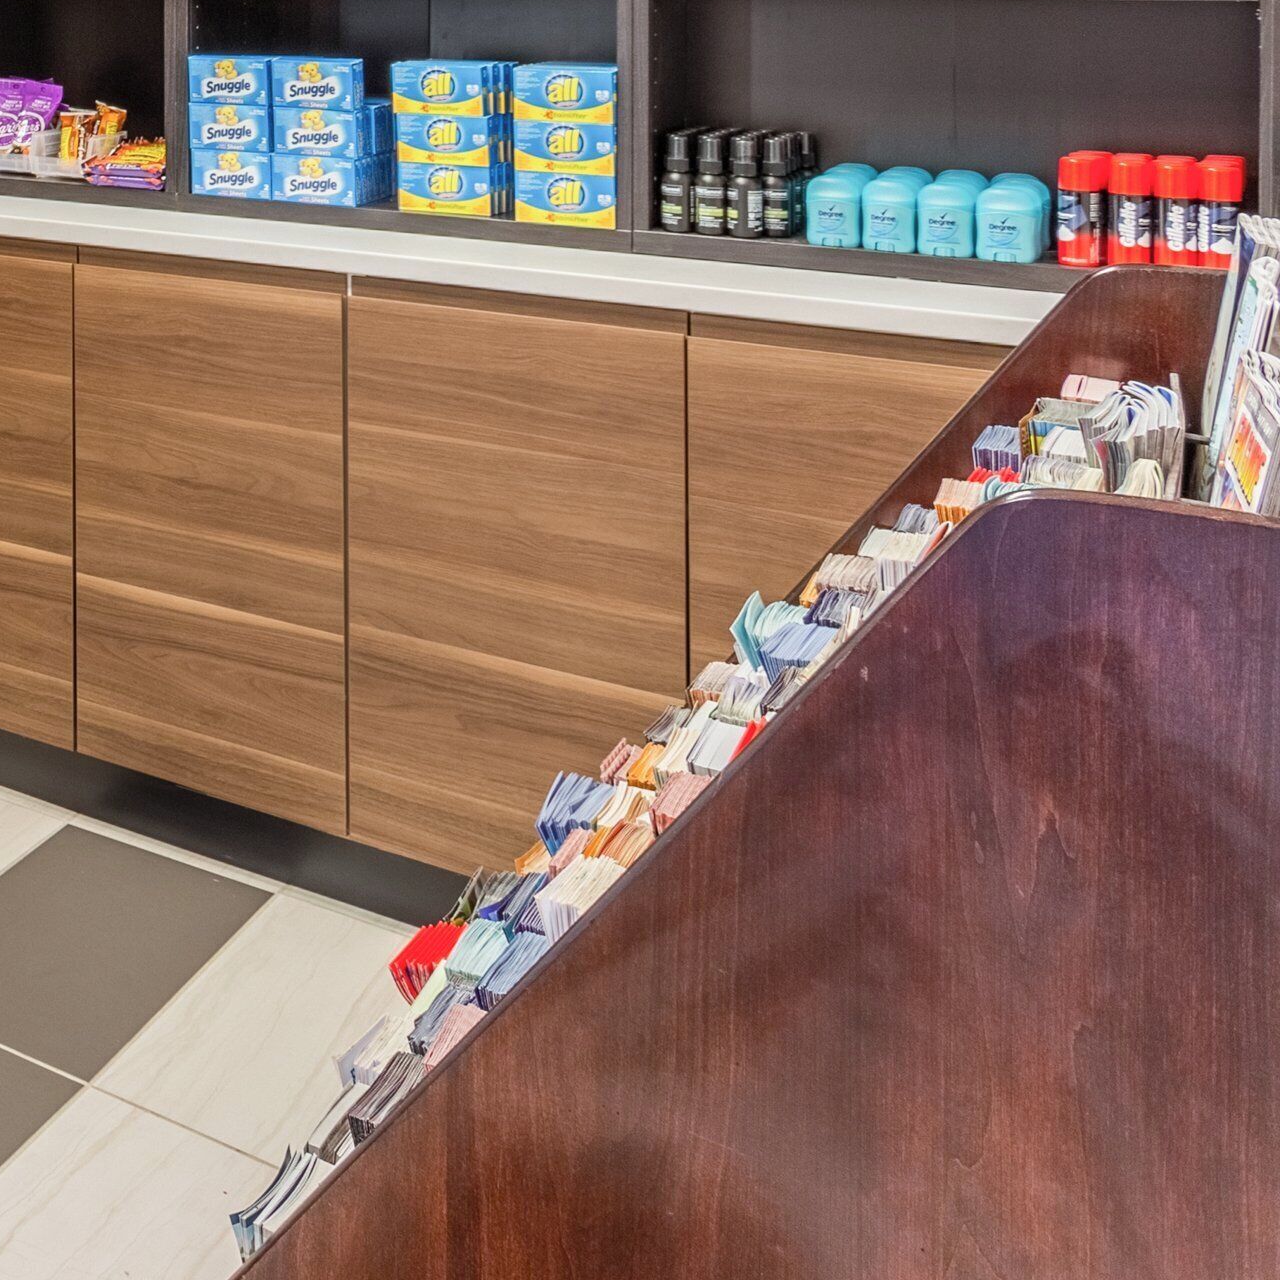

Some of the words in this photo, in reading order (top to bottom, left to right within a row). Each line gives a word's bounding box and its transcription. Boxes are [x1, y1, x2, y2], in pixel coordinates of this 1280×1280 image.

[206, 79, 251, 94] Snuggle
[290, 82, 336, 97] Snuggle
[423, 72, 452, 97] all
[548, 77, 579, 102] all
[207, 126, 252, 140] Snuggle
[292, 130, 338, 145] Snuggle
[428, 121, 457, 146] all
[548, 129, 580, 154] all
[209, 172, 254, 186] Snuggle
[290, 177, 337, 192] Snuggle
[429, 170, 460, 195] all
[549, 180, 581, 206] all
[817, 209, 844, 219] Degree
[871, 214, 896, 224] Degree
[928, 218, 956, 228] Degree
[988, 222, 1017, 233] Degree
[1120, 201, 1137, 248] Gillette
[1167, 205, 1185, 252] Gillette
[1198, 206, 1209, 252] Gillette
